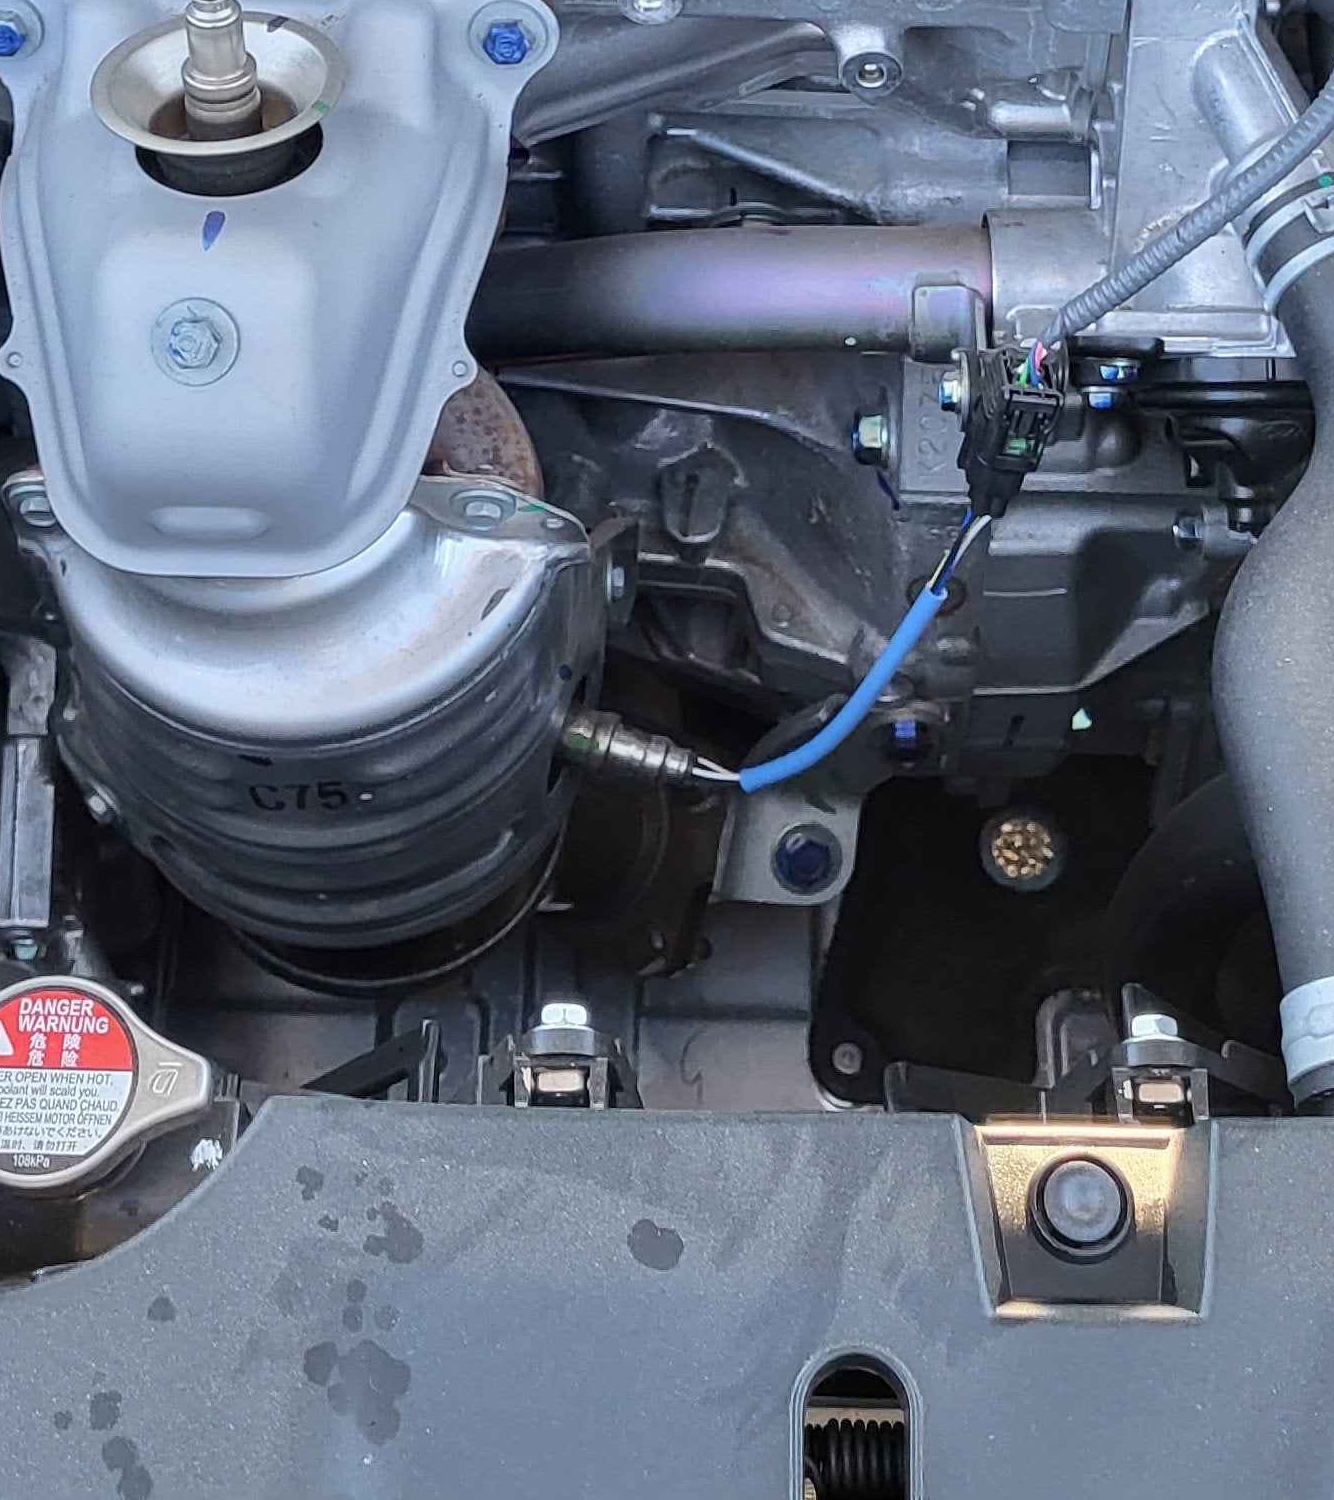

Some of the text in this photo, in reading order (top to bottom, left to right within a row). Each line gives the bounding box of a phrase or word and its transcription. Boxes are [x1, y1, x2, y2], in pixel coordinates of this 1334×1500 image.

[19, 998, 94, 1016] DANGER
[17, 1015, 110, 1034] WARNUNG
[15, 1071, 48, 1083] OPEN
[50, 1072, 84, 1084] WHEN
[31, 1084, 48, 1095] will
[49, 1085, 76, 1097] scald
[78, 1087, 100, 1100] you.
[14, 1097, 37, 1110] PAS
[39, 1098, 77, 1111] QUAND
[5, 1111, 43, 1124] HEISSEM
[44, 1113, 75, 1125] MOTOR
[12, 1154, 52, 1168] 108kPa
